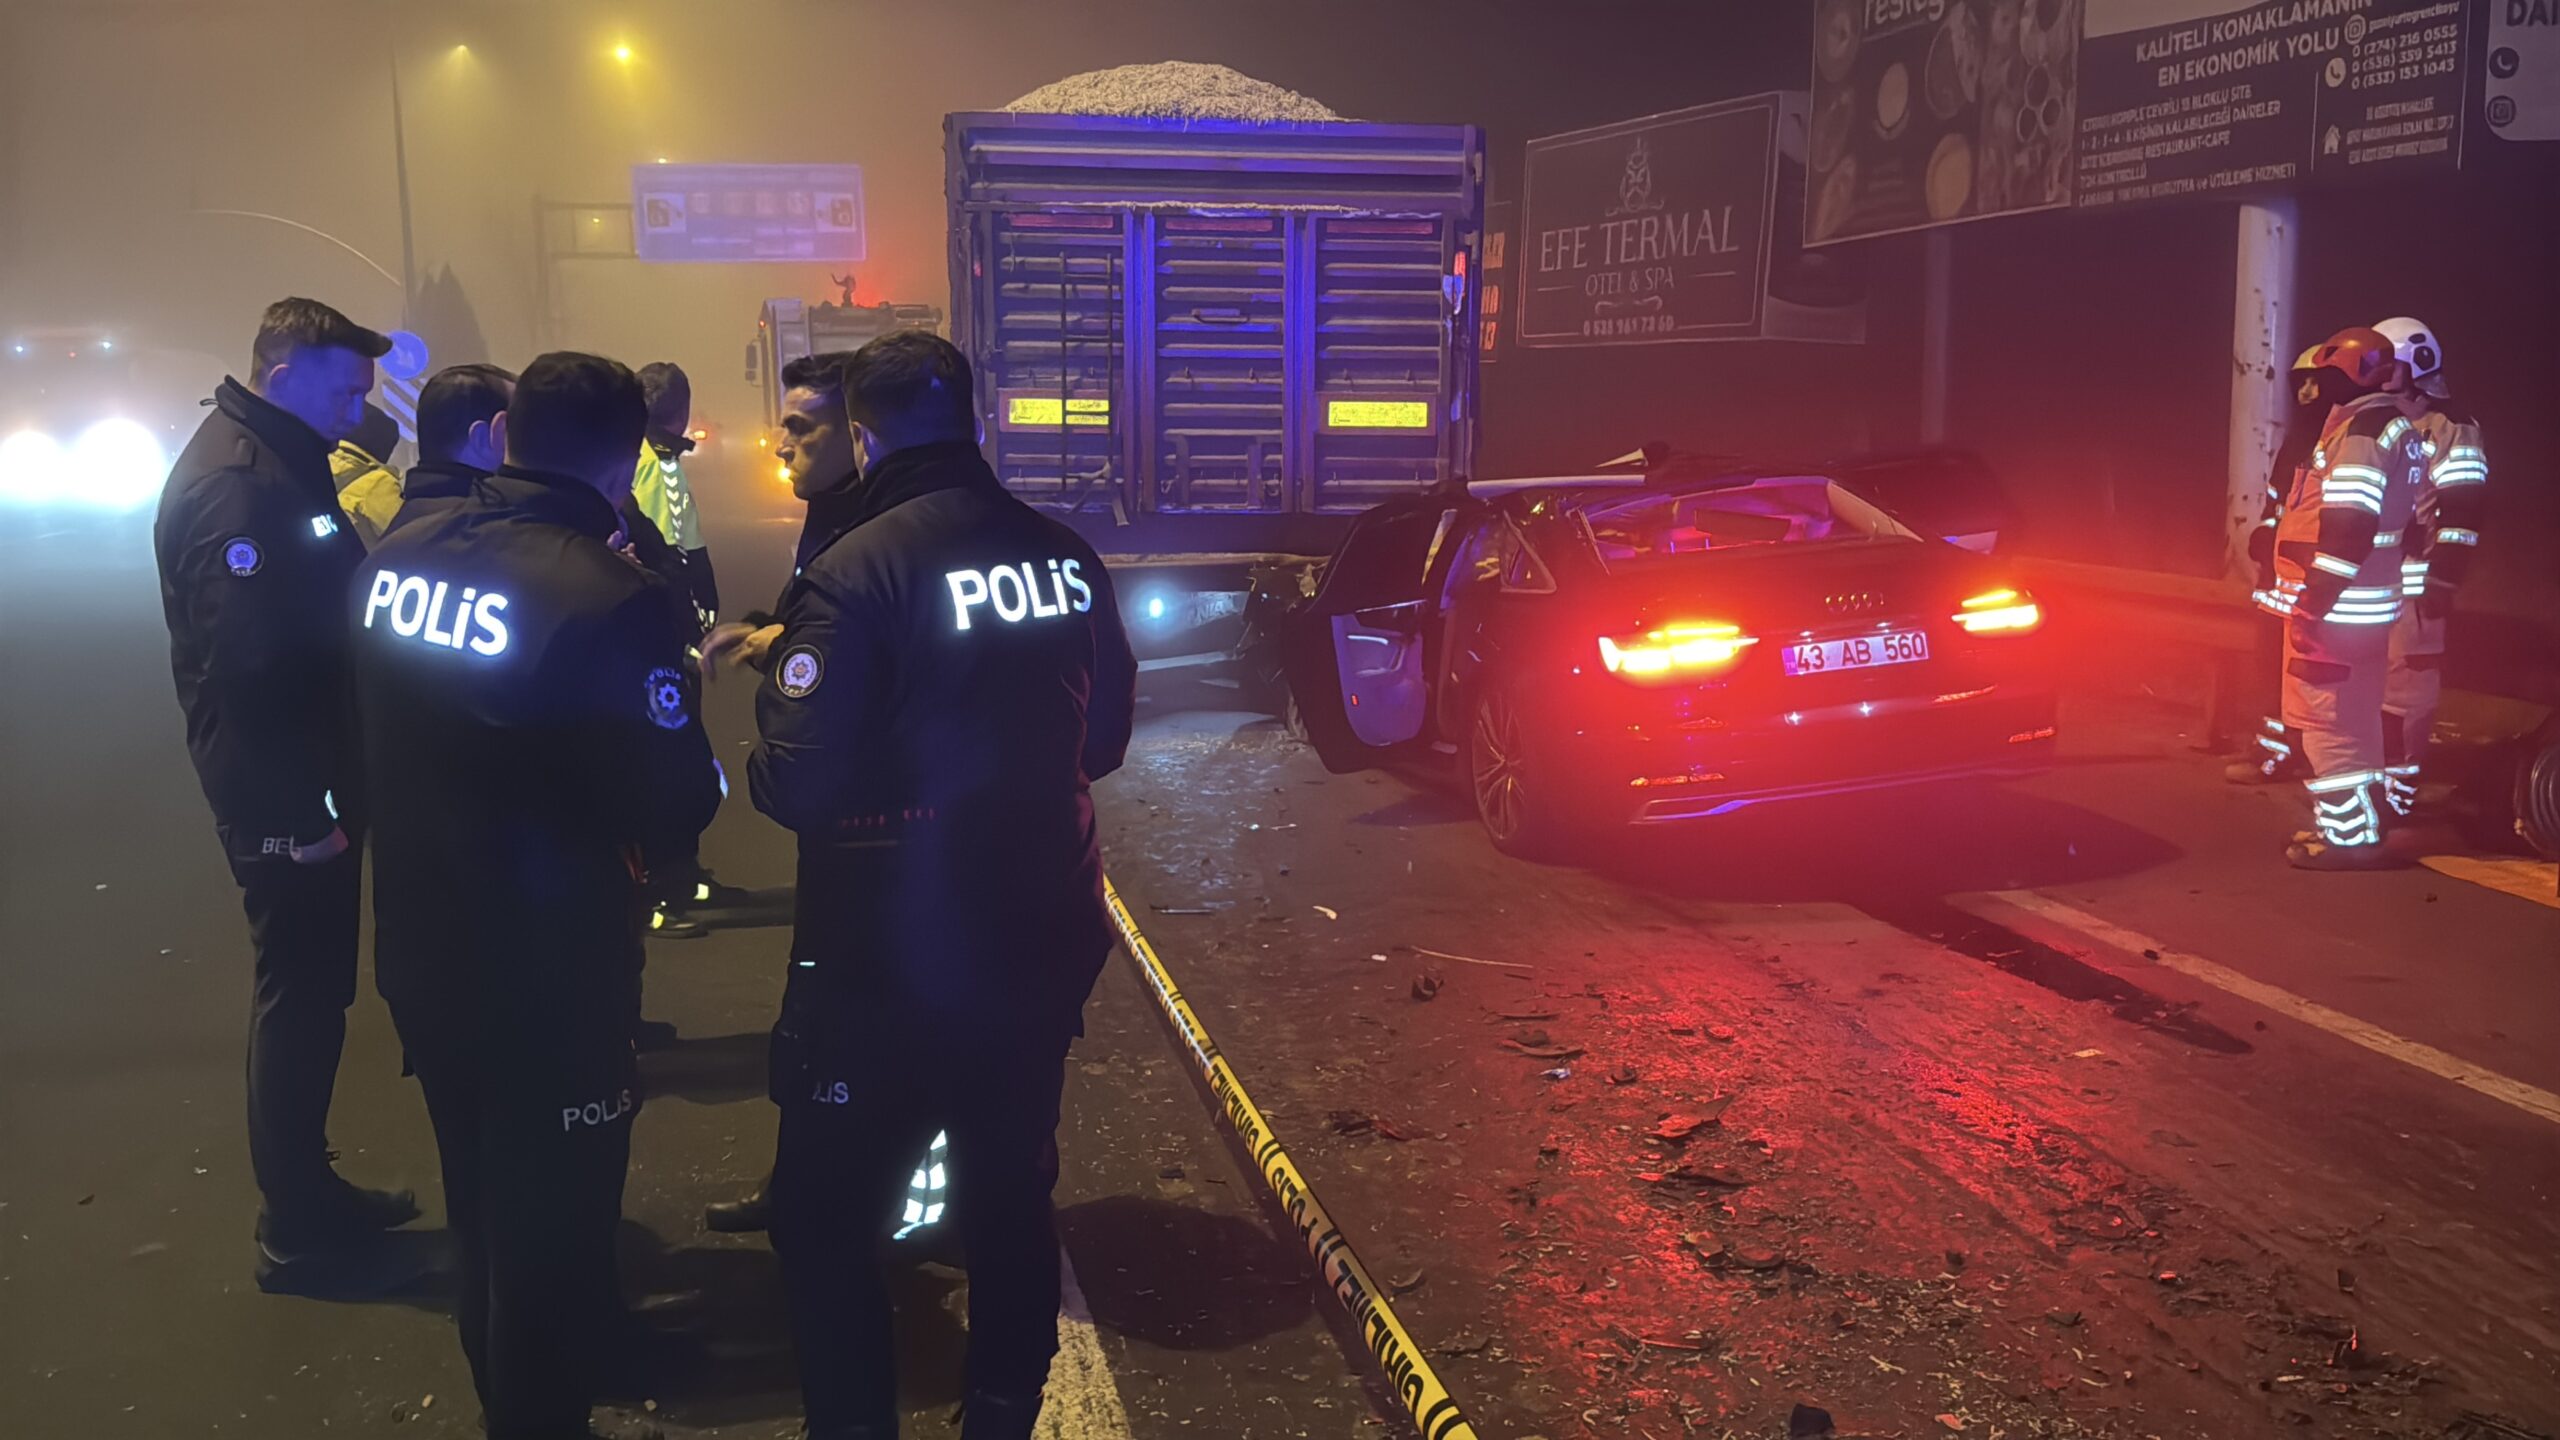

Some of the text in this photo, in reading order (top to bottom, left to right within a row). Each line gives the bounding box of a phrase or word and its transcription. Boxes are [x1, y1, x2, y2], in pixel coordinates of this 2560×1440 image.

[2158, 27, 2340, 87] EN EKONOMİK YOLU
[2399, 65, 2420, 80] 153
[2423, 58, 2455, 76] 1043
[1539, 225, 1591, 272] EFE
[1600, 205, 1739, 265] TERMAL
[1645, 266, 1675, 290] SPA
[1797, 632, 1926, 671] 43 AB 560
